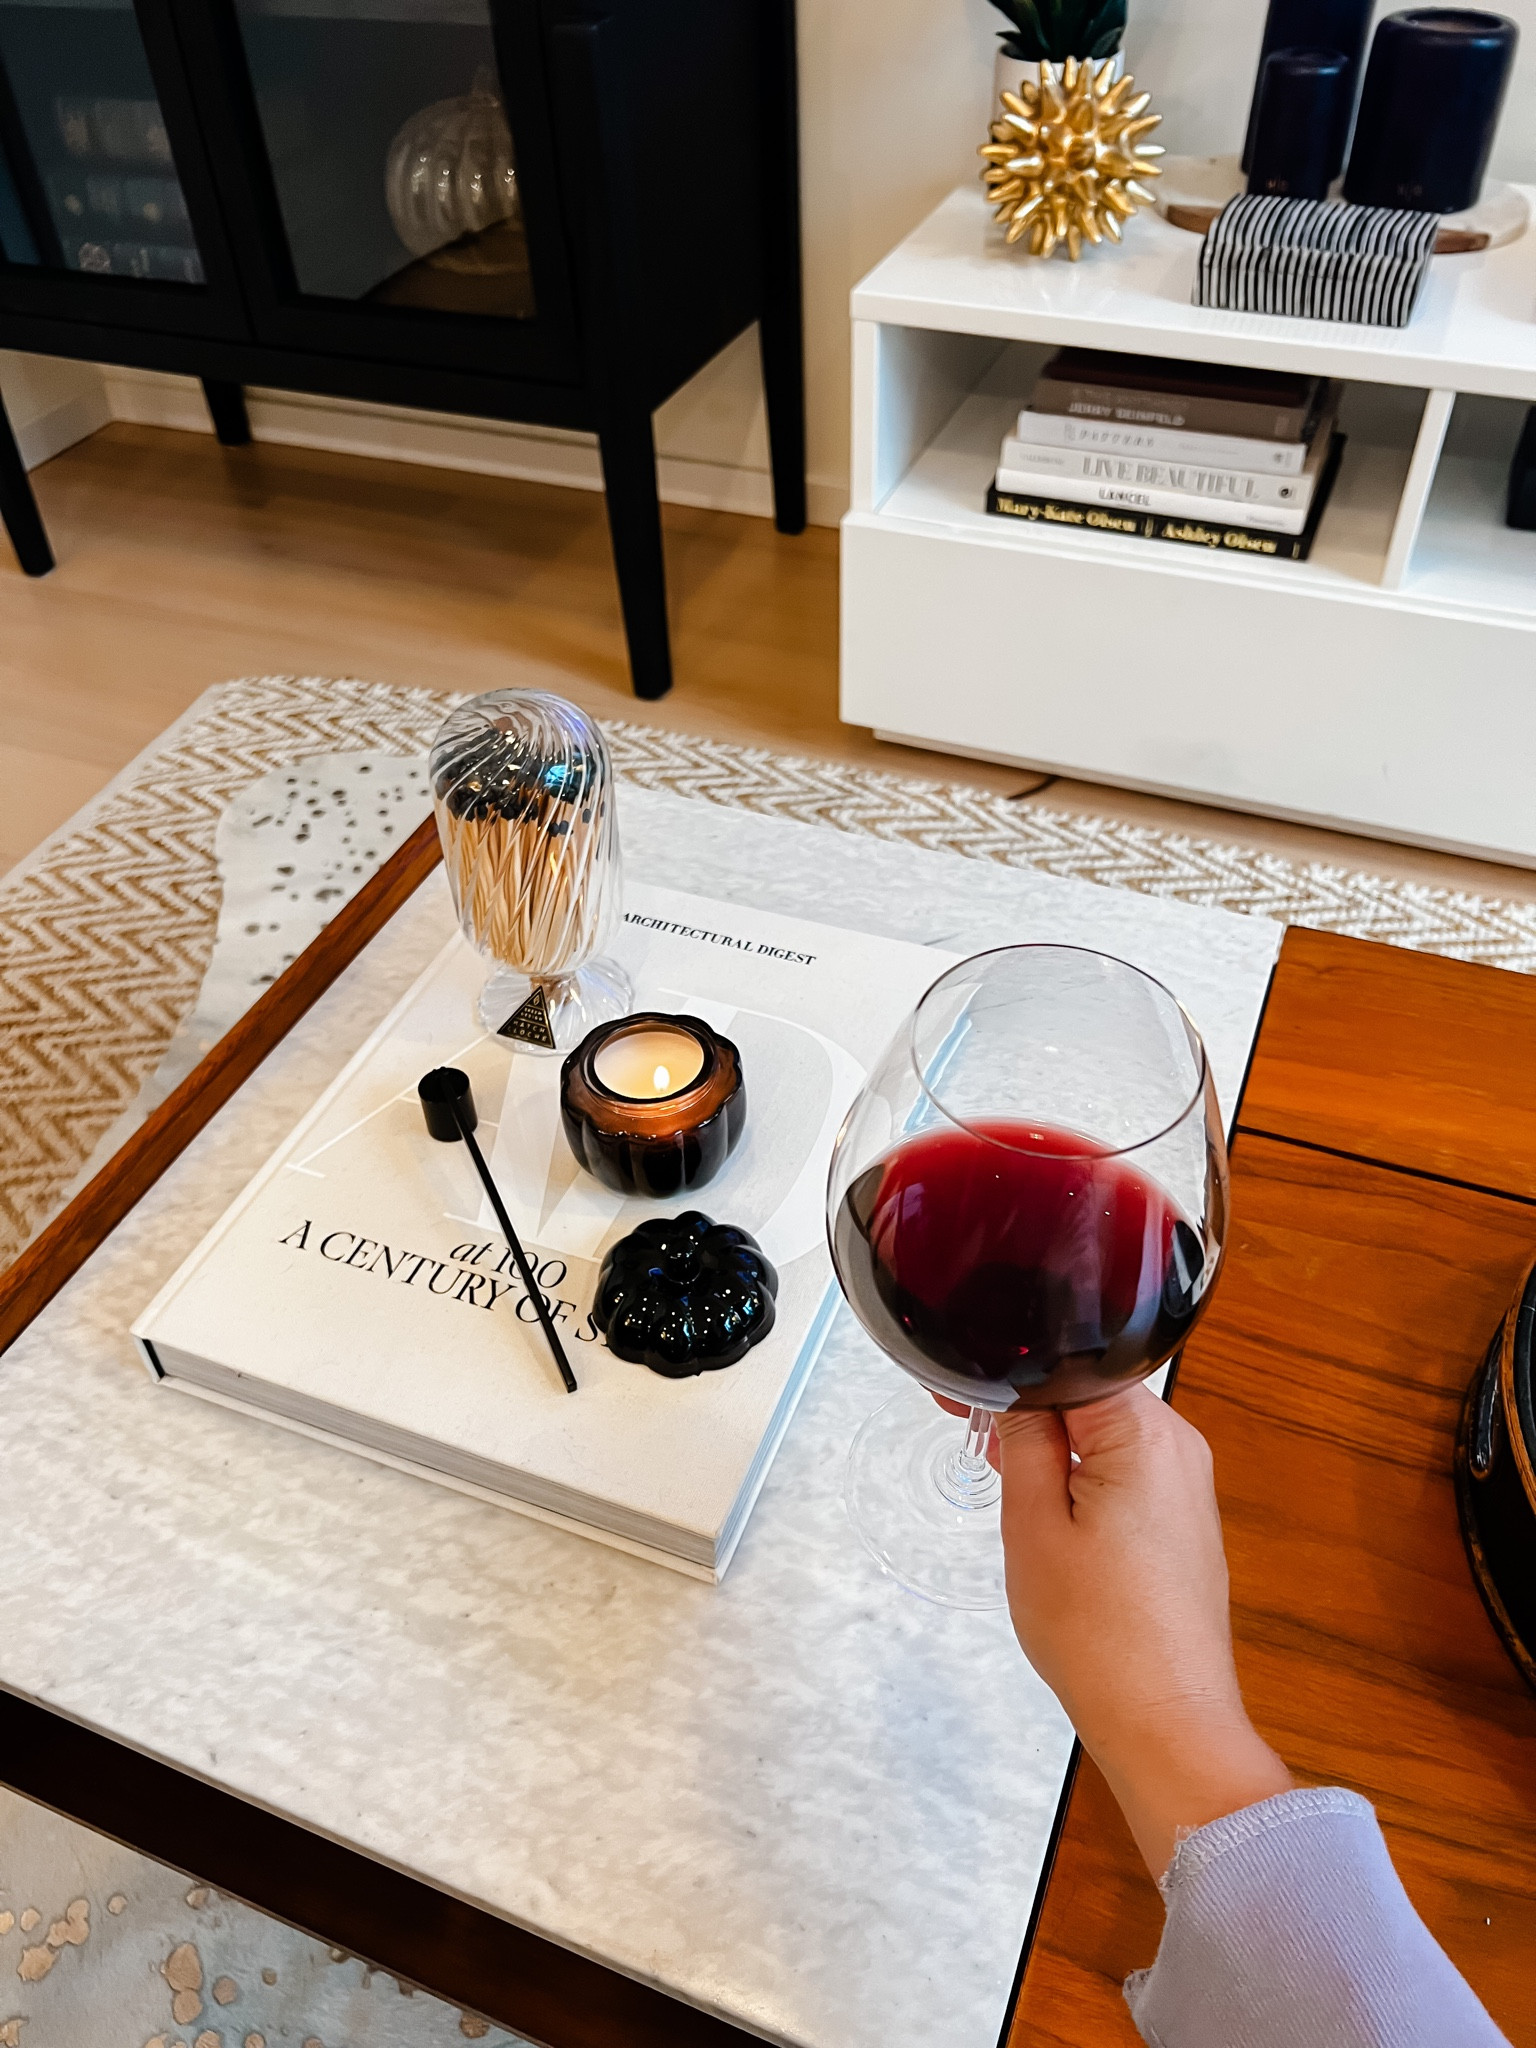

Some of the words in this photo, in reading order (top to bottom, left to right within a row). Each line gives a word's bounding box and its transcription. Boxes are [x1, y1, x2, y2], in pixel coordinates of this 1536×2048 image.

[1082, 457, 1133, 481] LIVE
[1135, 462, 1261, 500] BEAUTIFUL
[1086, 509, 1137, 533] Olsen
[1161, 522, 1222, 549] Ashley
[1223, 531, 1278, 554] Olsen
[623, 912, 754, 953] ARCHITECTURAL
[756, 943, 817, 966] DIGEST
[513, 1020, 546, 1033] MATCH
[278, 1219, 313, 1251] A
[319, 1230, 518, 1312] CENTURY
[515, 1292, 578, 1325] OF
[449, 1241, 495, 1267] at
